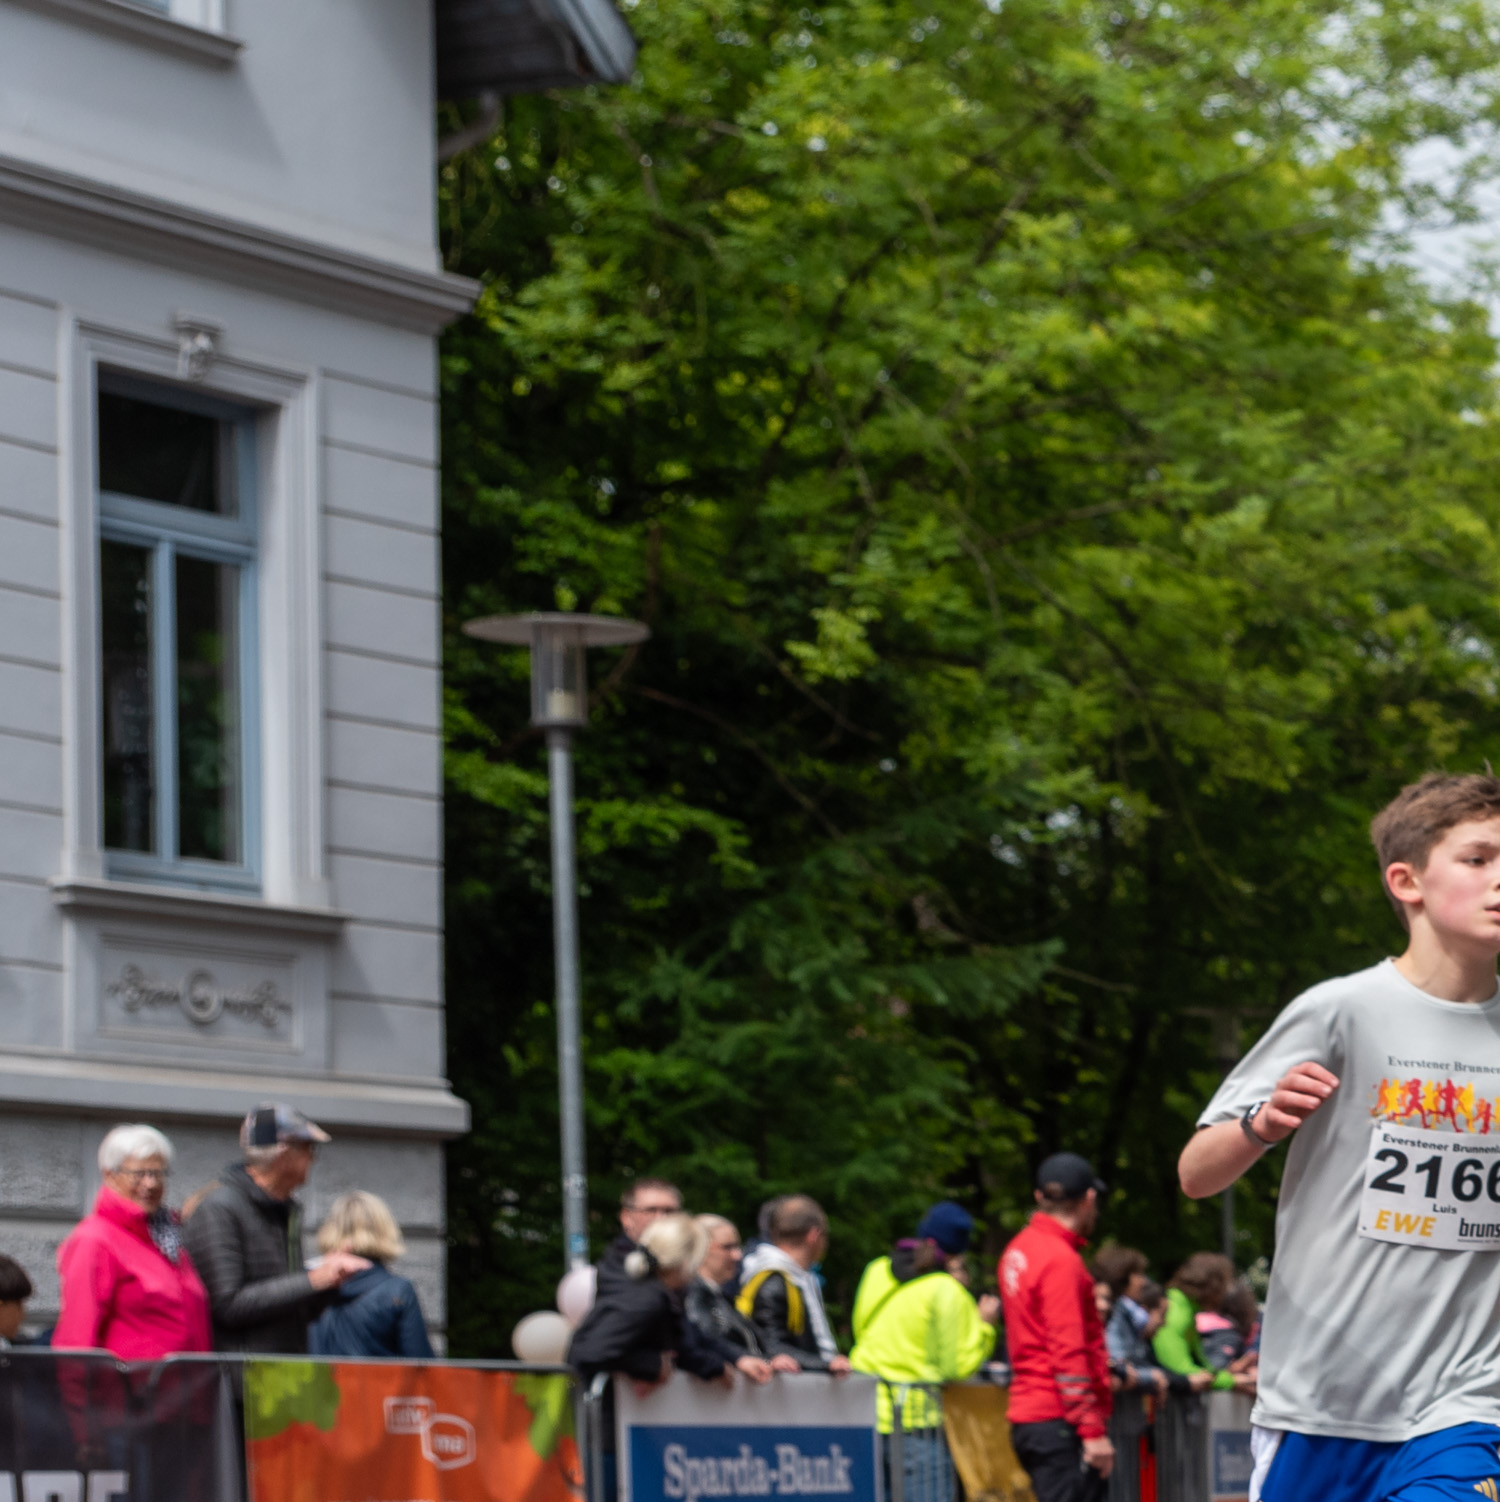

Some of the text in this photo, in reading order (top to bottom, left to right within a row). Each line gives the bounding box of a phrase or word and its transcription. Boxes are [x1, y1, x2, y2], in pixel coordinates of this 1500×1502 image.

[1387, 1055, 1451, 1071] Everstener
[1382, 1132, 1449, 1152] Everstener
[1432, 1203, 1458, 1215] Luis
[1374, 1209, 1438, 1238] EWE
